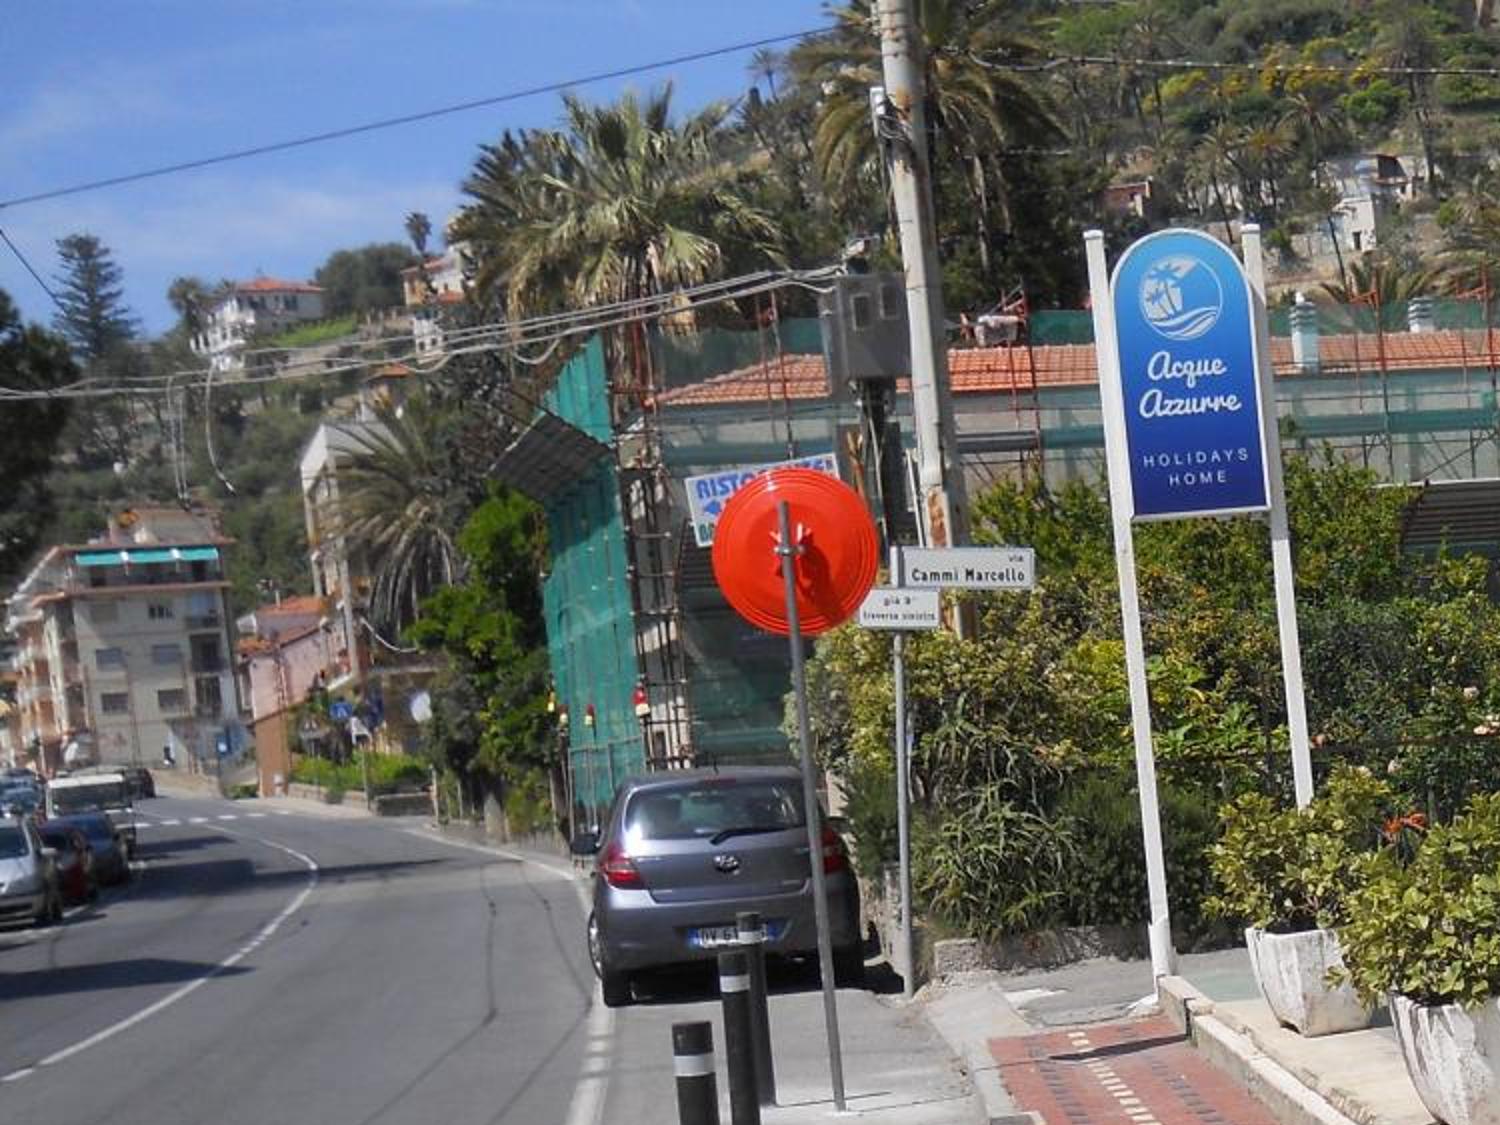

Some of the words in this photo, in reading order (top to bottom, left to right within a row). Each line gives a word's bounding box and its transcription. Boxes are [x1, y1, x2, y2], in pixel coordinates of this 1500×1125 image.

[1147, 350, 1227, 388] Acque
[1139, 389, 1243, 418] Azzurre
[1143, 447, 1249, 468] HOLIDAYS
[1169, 470, 1227, 487] HOME
[911, 568, 959, 582] Cammi
[965, 568, 1025, 582] Marcello
